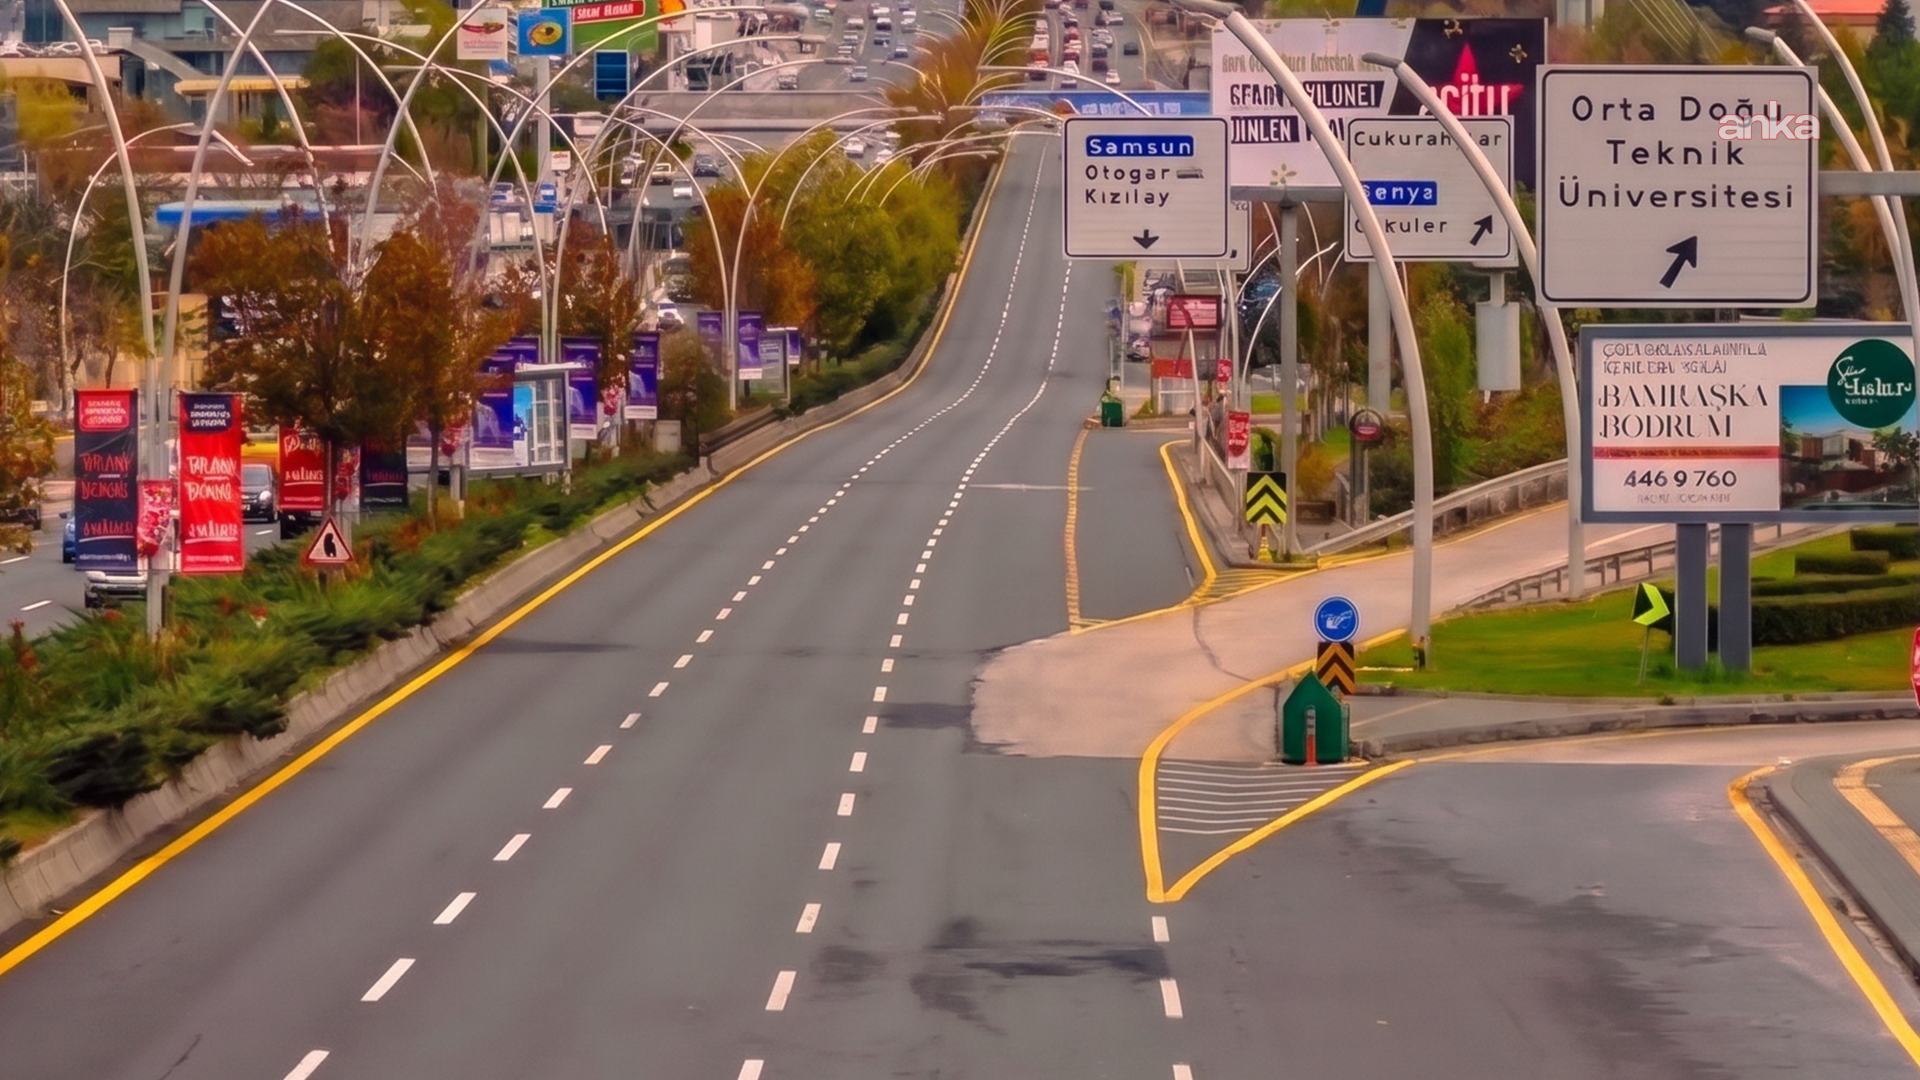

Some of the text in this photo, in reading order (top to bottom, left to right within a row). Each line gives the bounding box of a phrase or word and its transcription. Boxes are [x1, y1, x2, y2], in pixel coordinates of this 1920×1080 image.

[1572, 95, 1782, 128] Orta Doğu
[1089, 138, 1191, 155] Samsun
[1606, 140, 1745, 165] Teknik
[1085, 164, 1170, 184] Otogar
[1085, 188, 1169, 207] Kızılay
[1559, 176, 1793, 208] Üniversitesi
[1599, 414, 1731, 438] BODRUM
